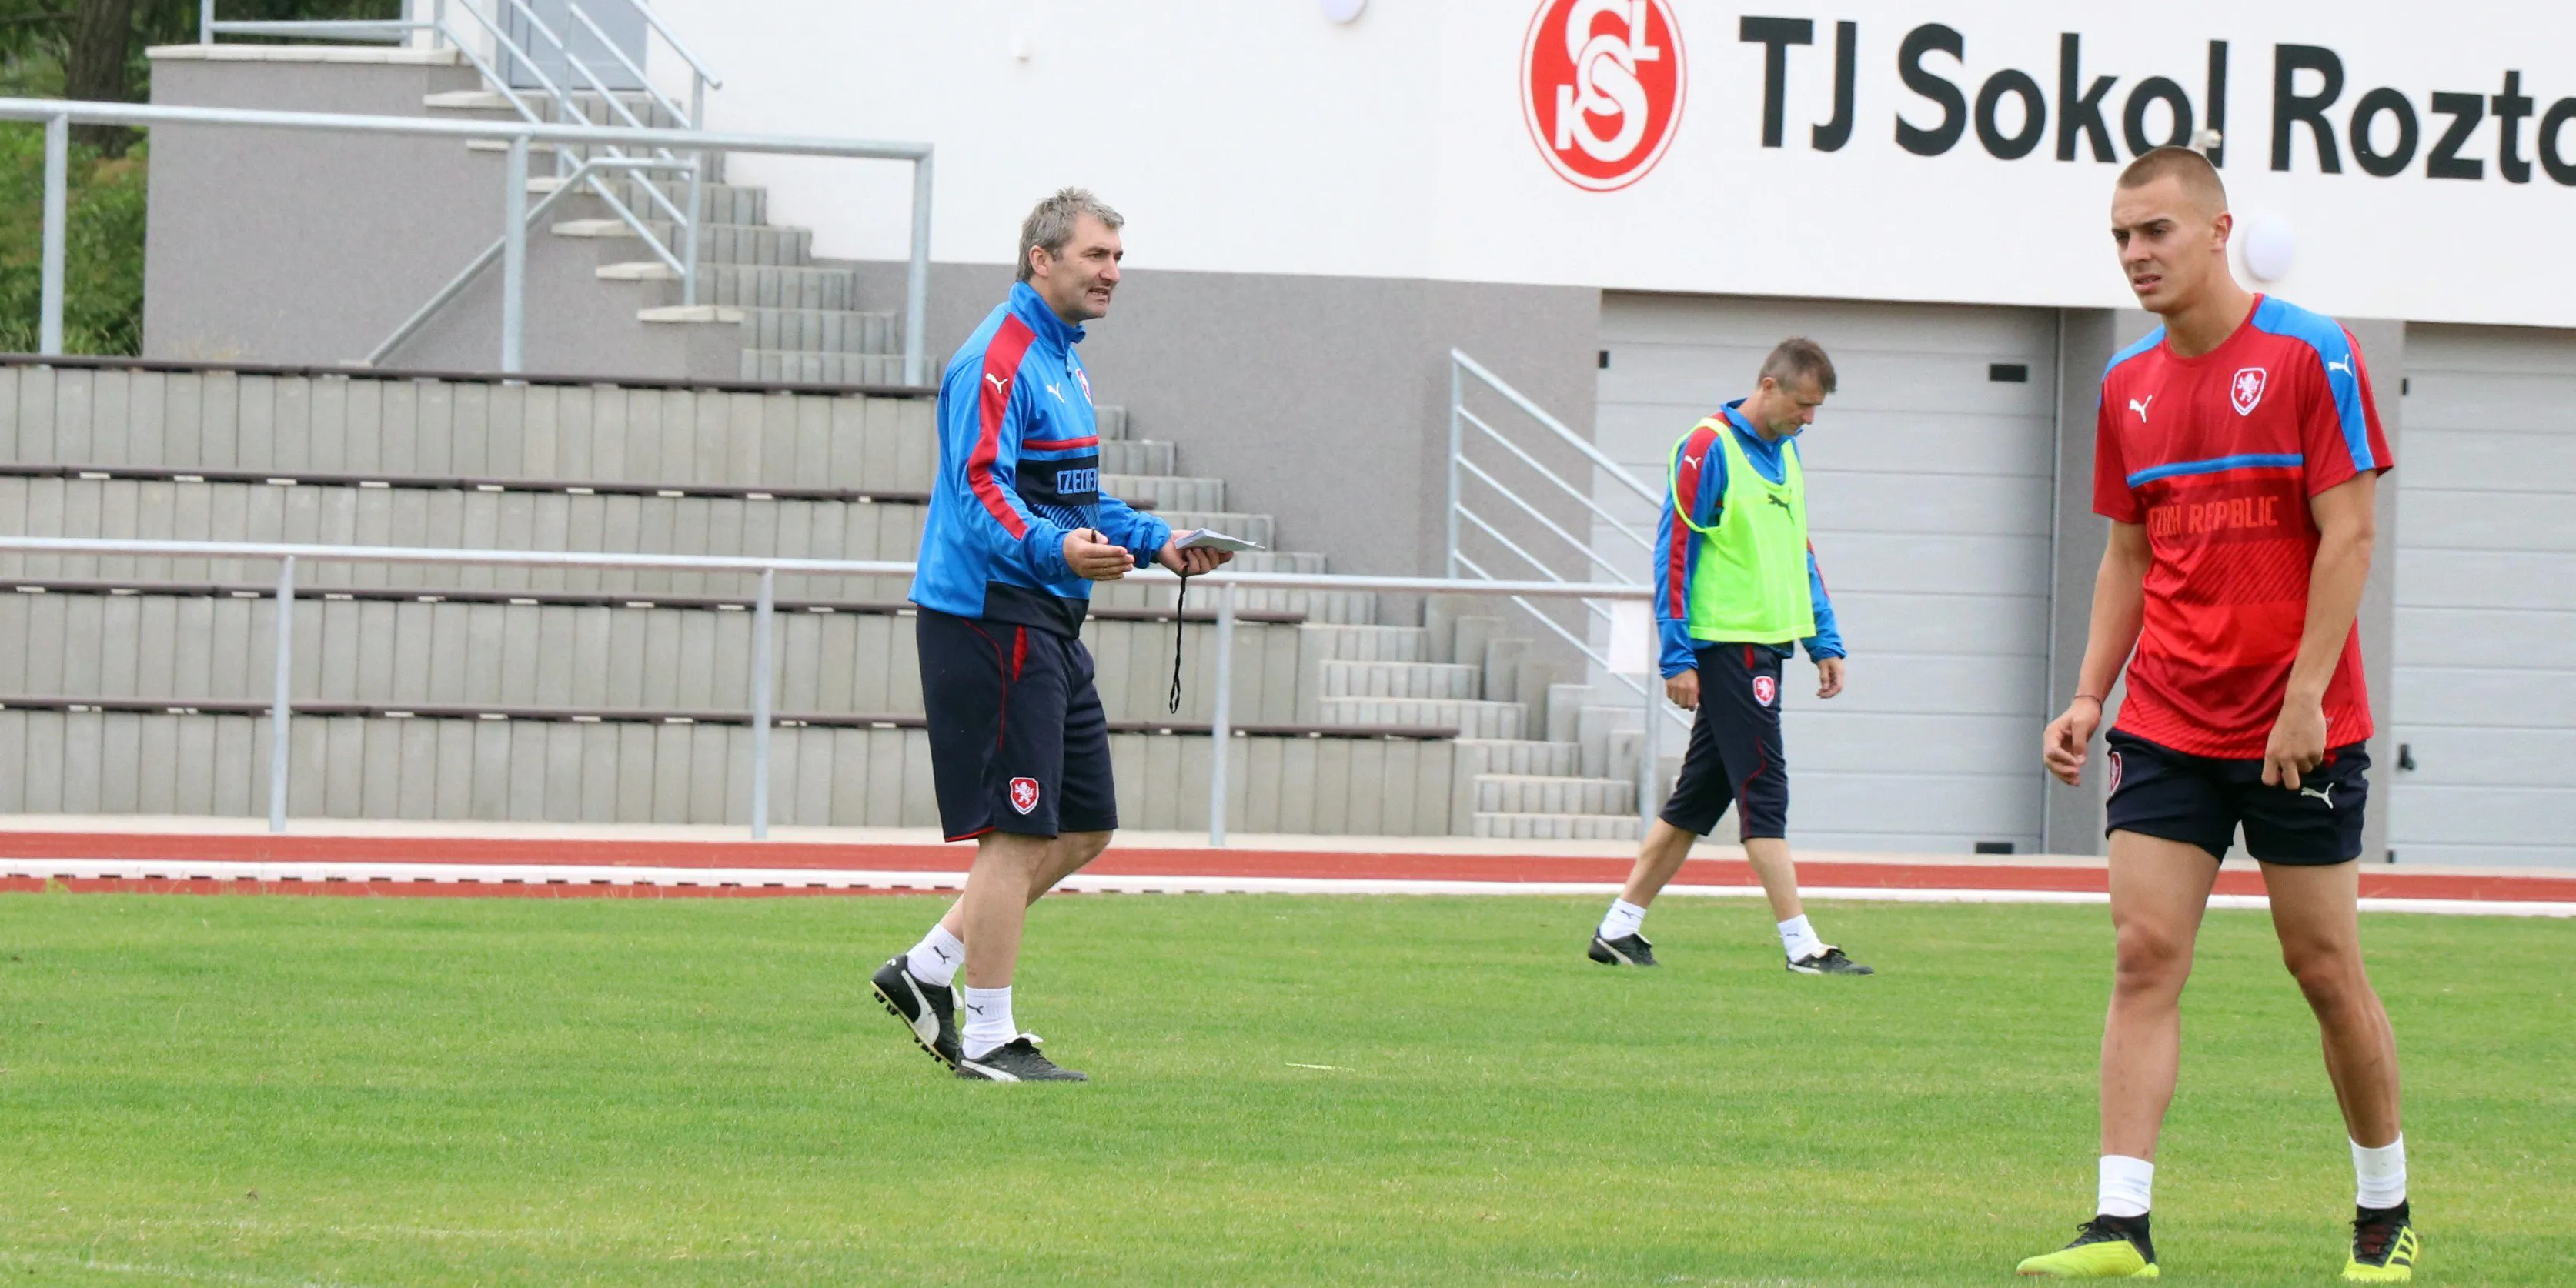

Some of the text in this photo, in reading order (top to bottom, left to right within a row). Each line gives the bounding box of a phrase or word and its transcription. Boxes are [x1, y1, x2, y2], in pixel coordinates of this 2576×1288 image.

[1739, 15, 2576, 186] TJ Sokol Rozto
